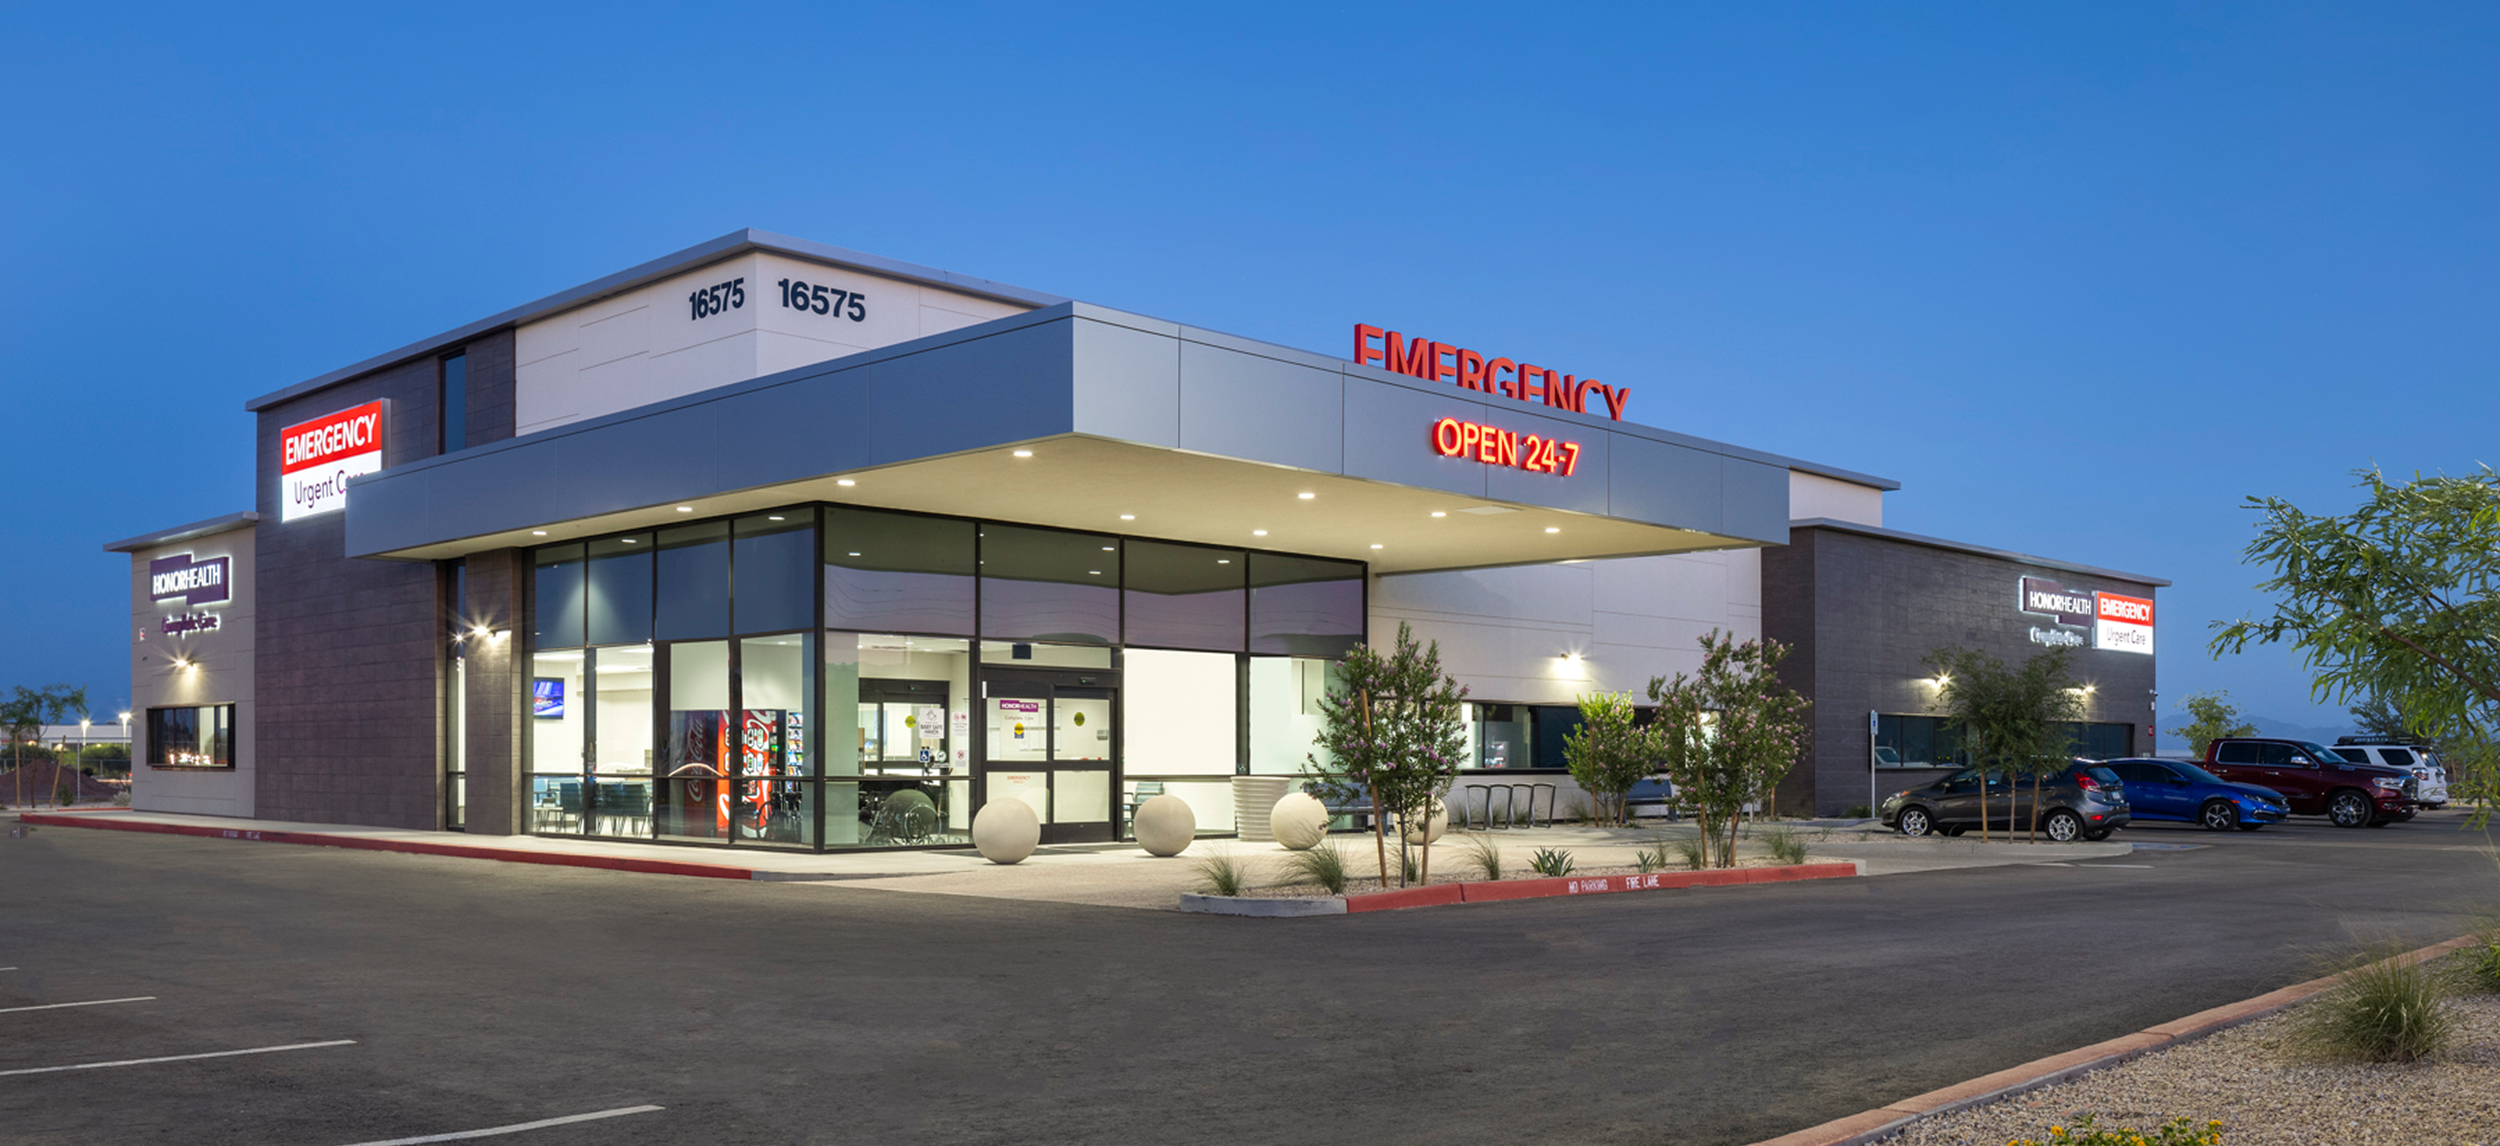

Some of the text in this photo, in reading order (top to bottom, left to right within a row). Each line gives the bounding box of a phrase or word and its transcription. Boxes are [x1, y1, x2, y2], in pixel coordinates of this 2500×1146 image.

[689, 277, 745, 321] 16575
[778, 278, 866, 322] 16575
[1354, 323, 1630, 421] EMERGENCY
[286, 412, 377, 466] EMERGENCY
[1433, 417, 1579, 476] OPEN 24-7
[294, 476, 334, 509] Urgent
[152, 563, 221, 595] HONORHEALTH
[2029, 590, 2092, 615] HONORHEALTH
[2100, 597, 2150, 621] EMERGENCY
[2106, 626, 2146, 646] Urgent Care
[1568, 874, 1660, 893] NO PARKING FIRE LANE
